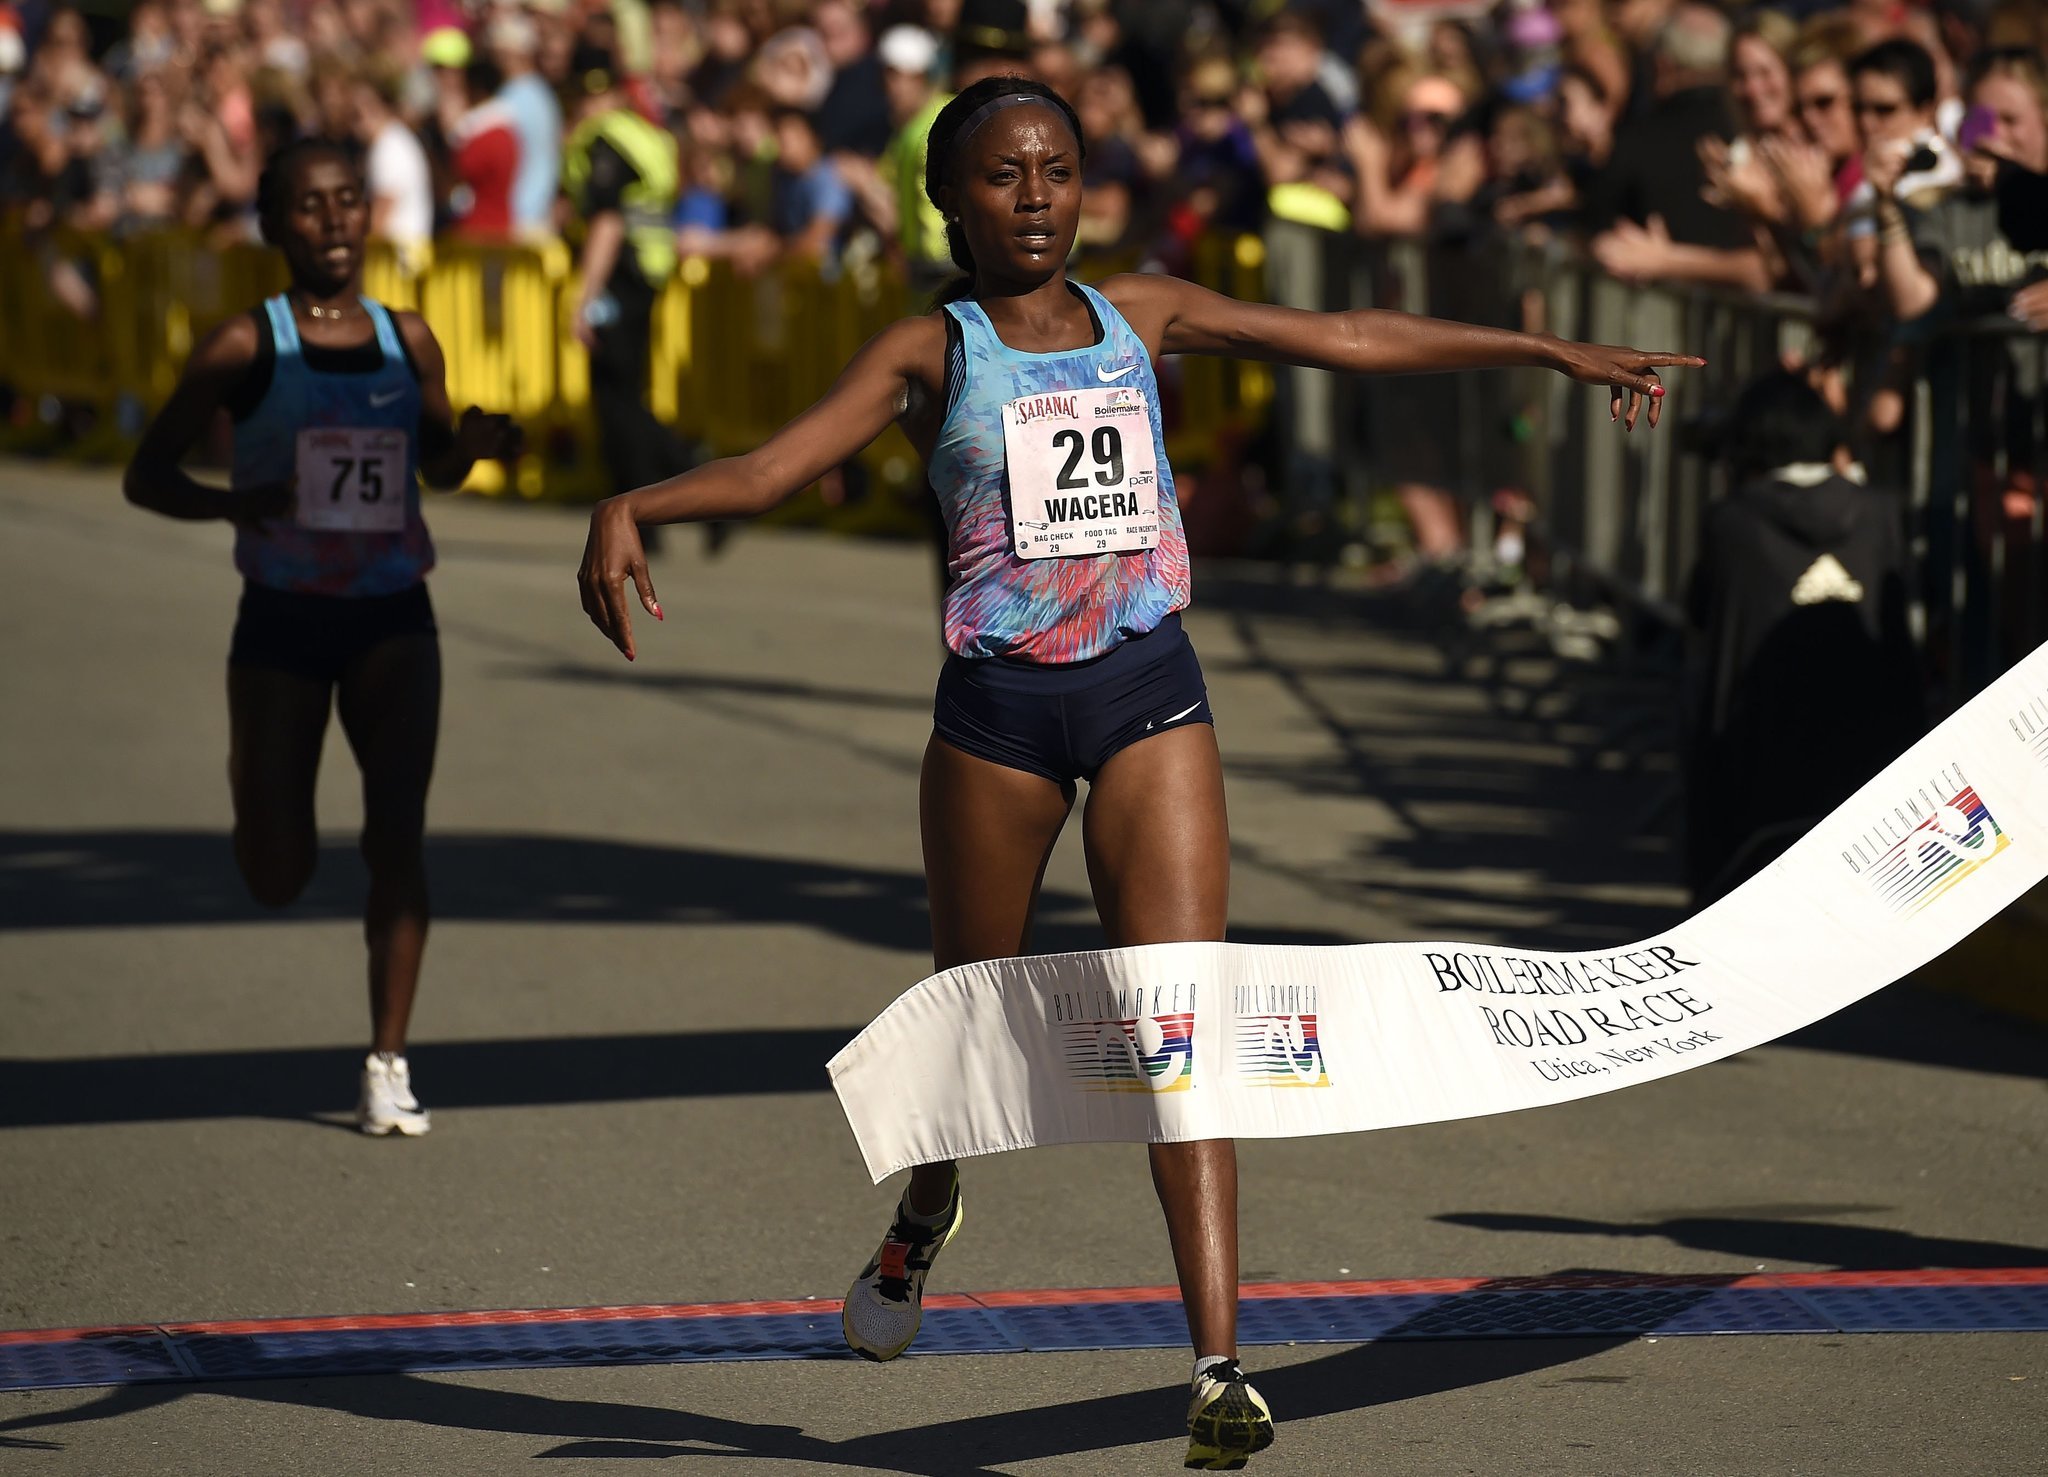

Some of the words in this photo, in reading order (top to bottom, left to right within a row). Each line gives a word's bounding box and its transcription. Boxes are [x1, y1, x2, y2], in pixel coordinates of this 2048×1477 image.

[1019, 395, 1079, 424] SARANAC
[1094, 404, 1140, 415] Boilermaker
[1052, 426, 1125, 490] 29
[329, 457, 384, 504] 75
[1044, 492, 1139, 523] WACERA
[1034, 534, 1049, 542] BAG
[1050, 532, 1074, 541] CHECK
[1049, 543, 1060, 552] 29
[1084, 529, 1103, 537] FOOD
[1105, 528, 1117, 536] TAG
[1096, 539, 1107, 549] 29
[1140, 535, 1147, 544] 29
[1842, 762, 1968, 873] BOILERMAKER
[1422, 945, 1701, 996] BOILERMAKER
[1479, 1005, 1587, 1047] ROAD
[1581, 987, 1713, 1037] RACE
[1530, 1059, 1611, 1082] Utica,
[1596, 1040, 1659, 1068] New
[1651, 1029, 1724, 1055] York
